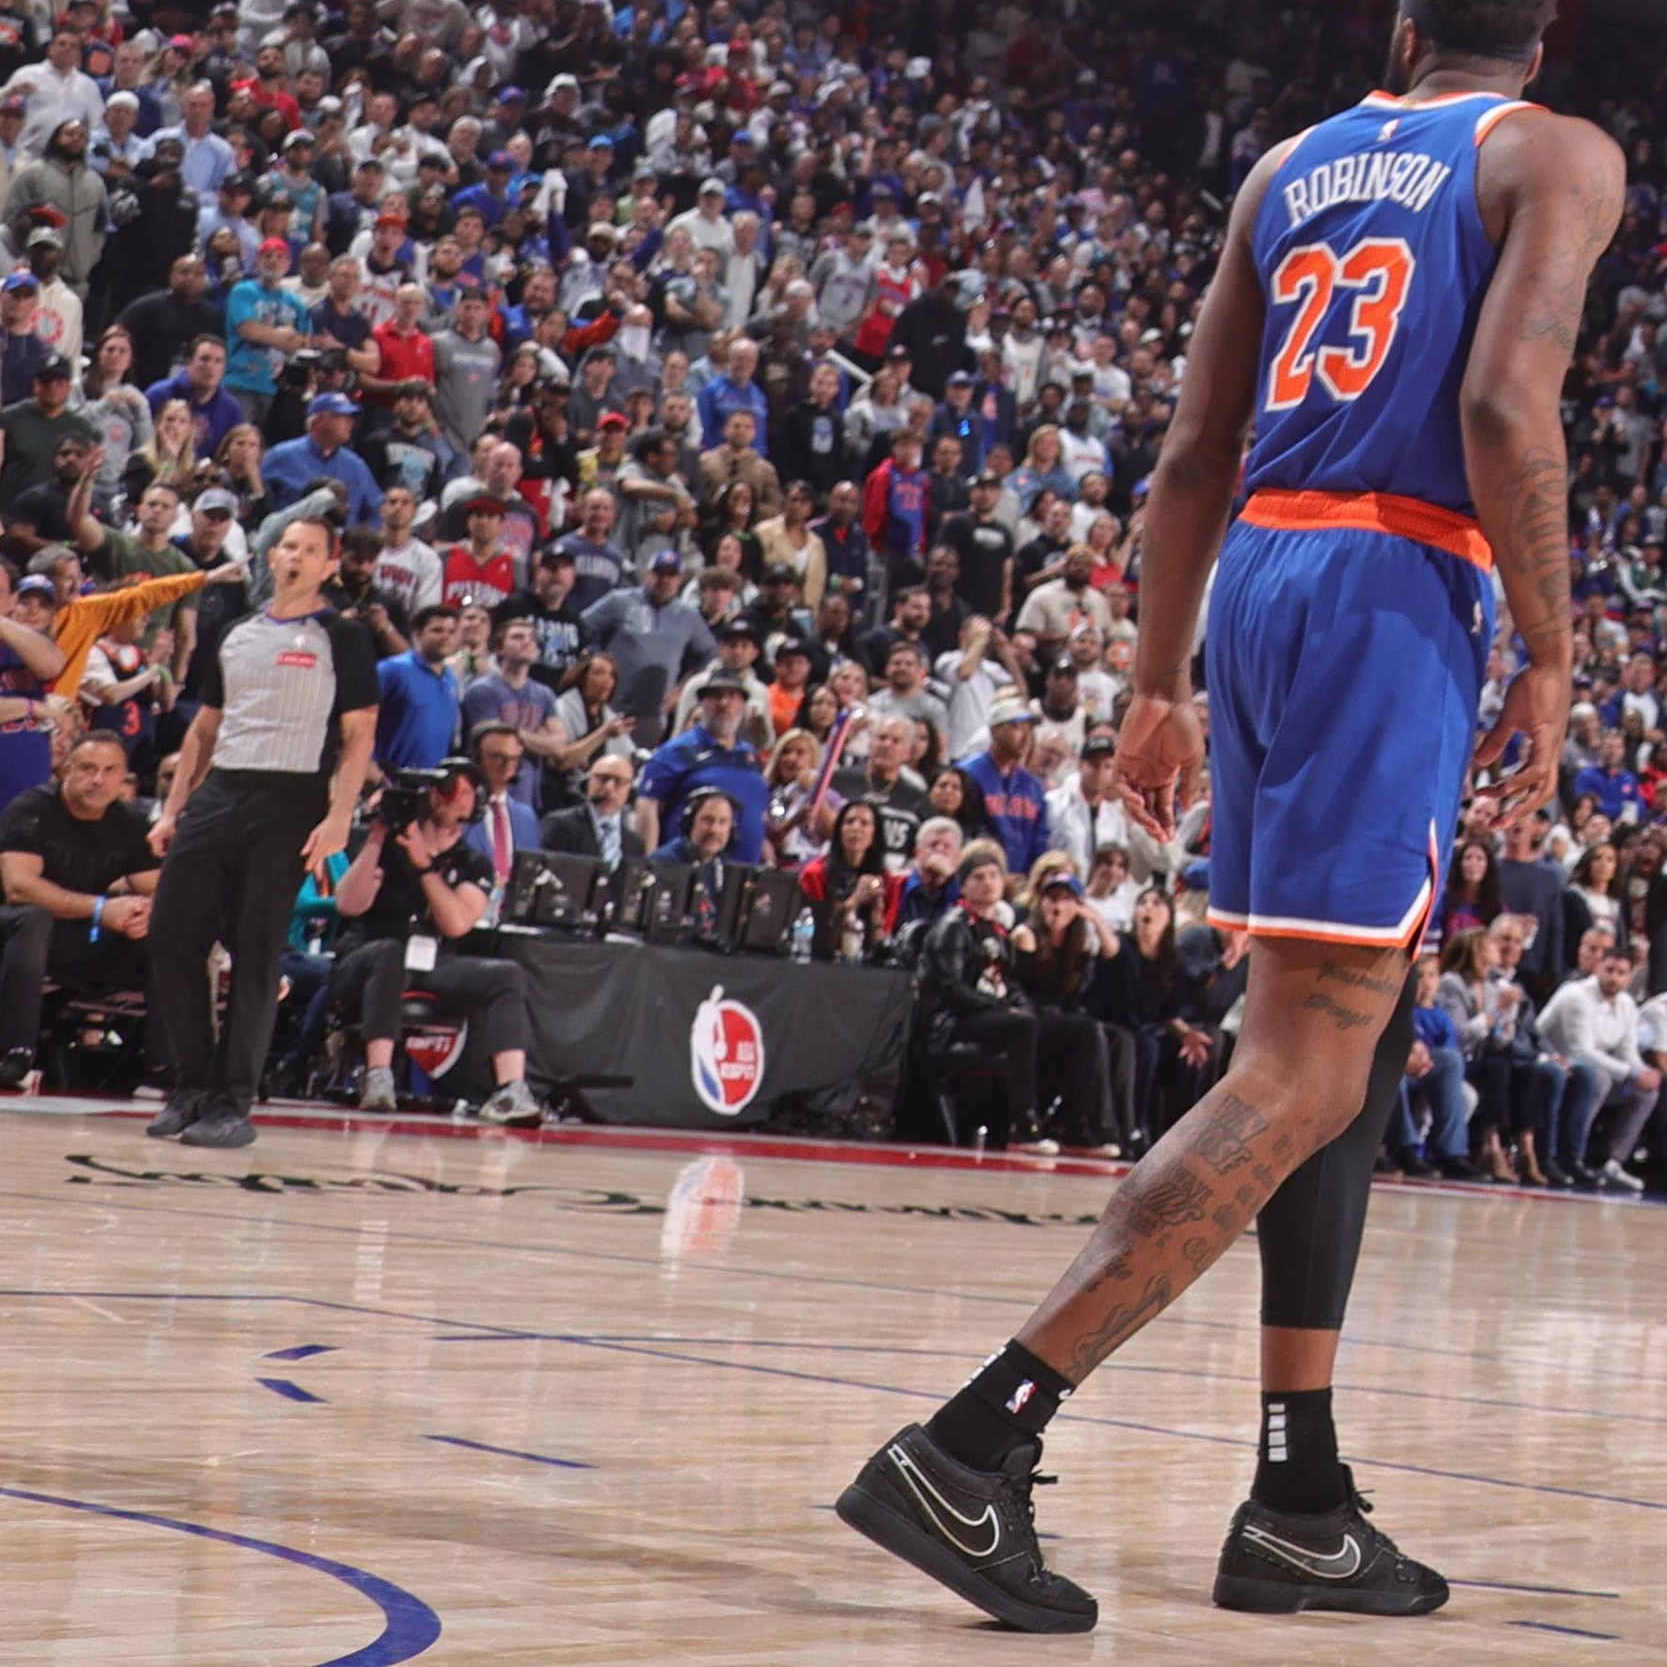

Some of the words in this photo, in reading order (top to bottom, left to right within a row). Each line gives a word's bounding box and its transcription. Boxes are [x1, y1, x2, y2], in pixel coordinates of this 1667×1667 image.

[1283, 152, 1451, 228] ROBINSON
[1265, 237, 1416, 413] 23
[123, 701, 141, 735] 3
